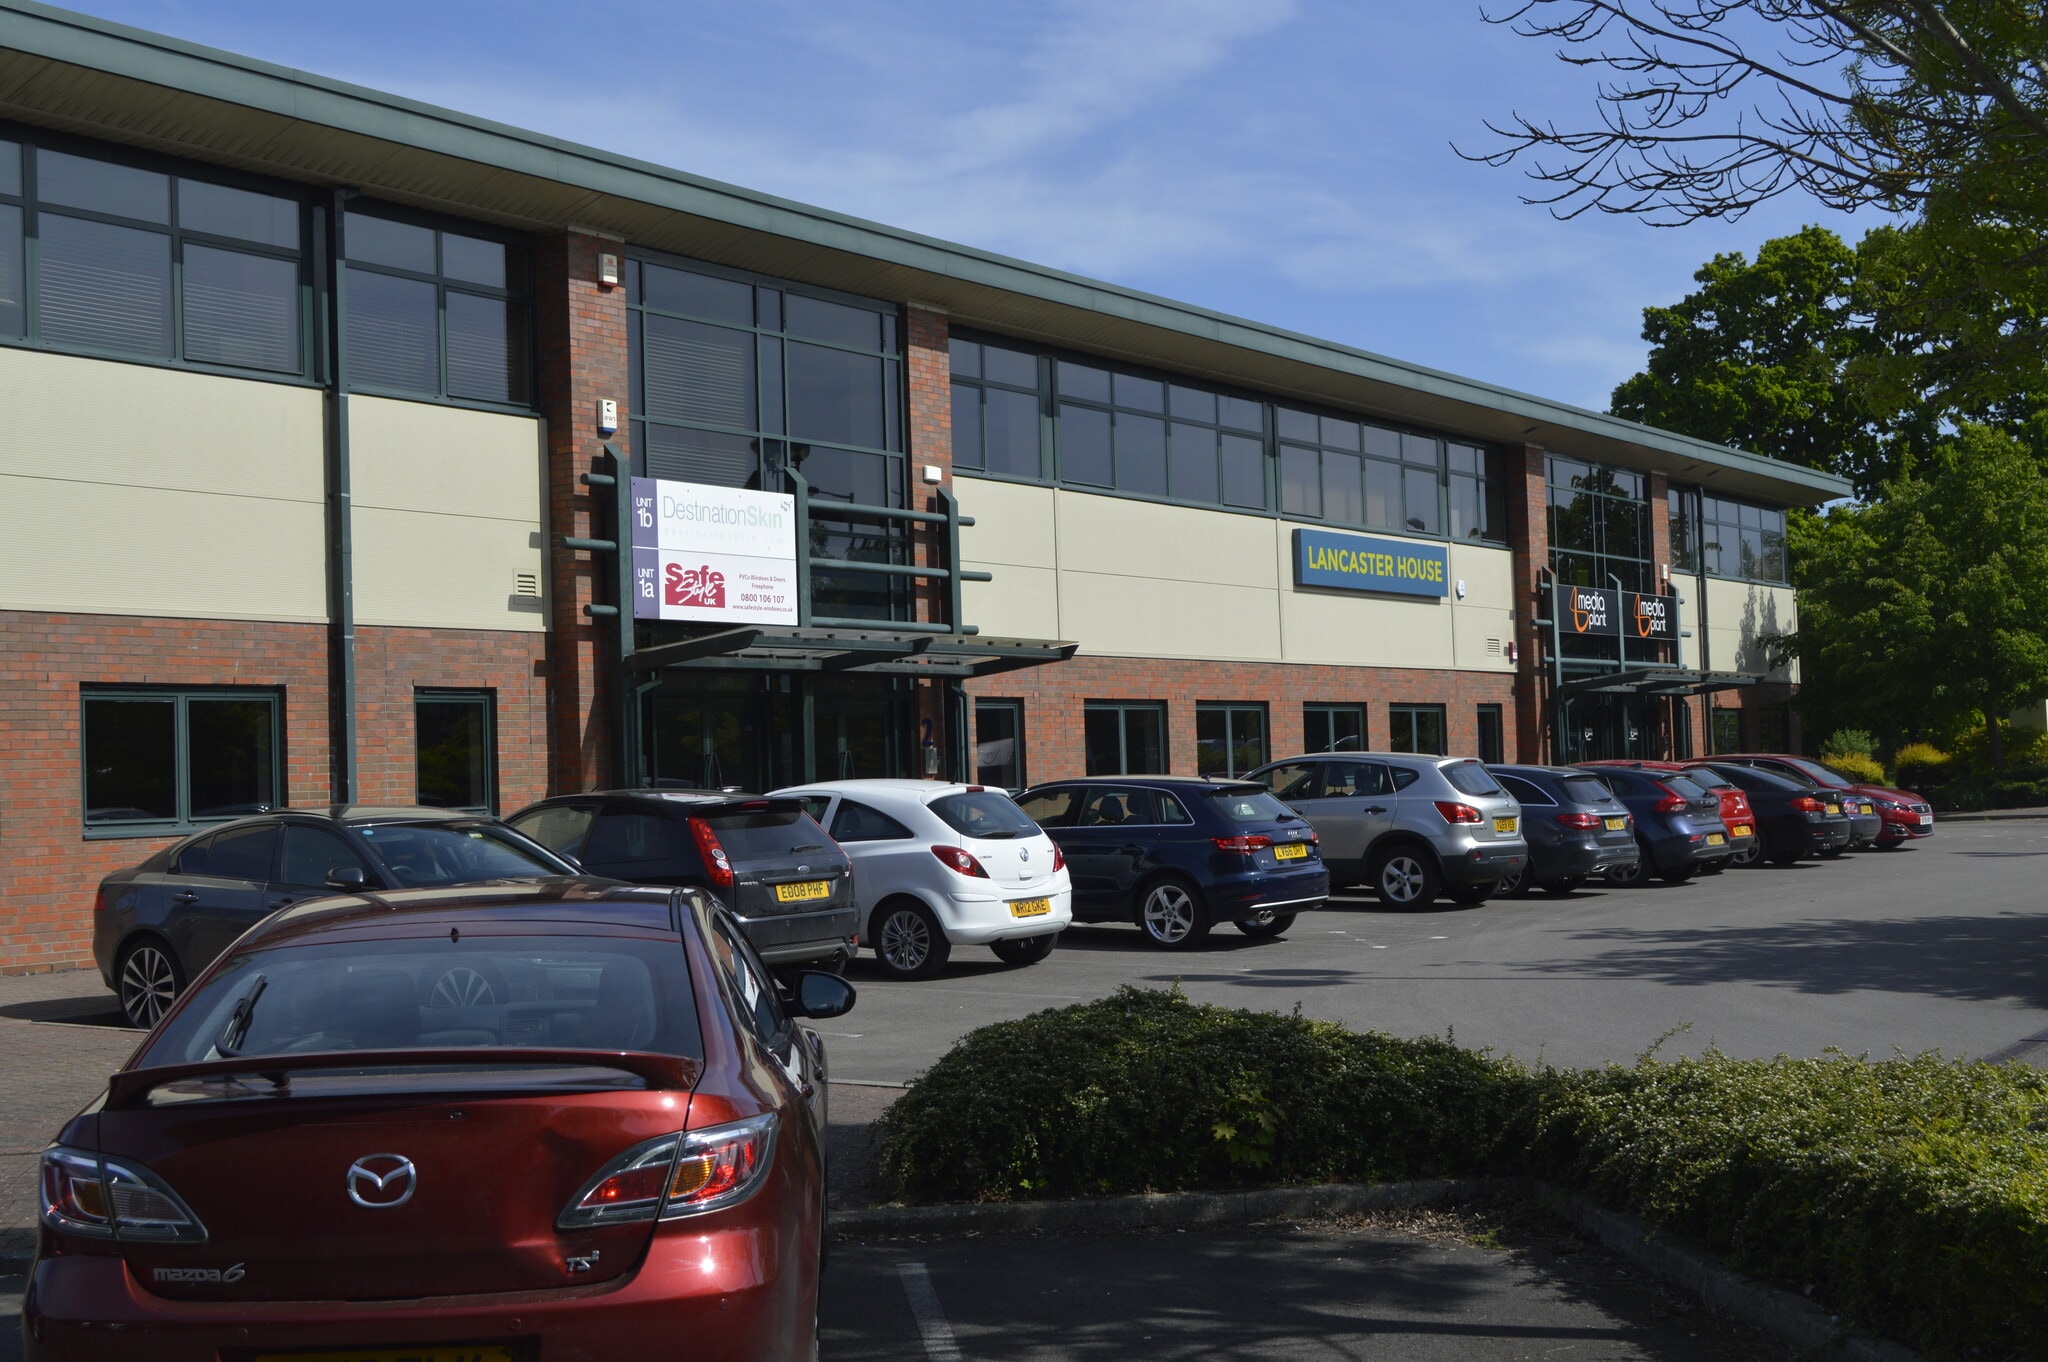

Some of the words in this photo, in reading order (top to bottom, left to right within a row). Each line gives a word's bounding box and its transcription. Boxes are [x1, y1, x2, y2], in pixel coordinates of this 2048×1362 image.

[636, 497, 653, 508] UNIT
[663, 495, 783, 529] DestinationSkin
[637, 508, 653, 528] 1b
[638, 568, 654, 579] UNIT
[665, 562, 725, 585] Safe
[1308, 545, 1394, 577] LANCASTER
[1397, 556, 1443, 583] HOUSE
[639, 578, 655, 598] 1a
[675, 579, 717, 605] Style
[704, 597, 716, 606] UK
[740, 593, 757, 602] 0800
[759, 594, 772, 603] 106
[773, 595, 785, 604] 107
[1578, 591, 1605, 611] media
[1640, 598, 1665, 616] media
[1588, 611, 1606, 630] plant
[1650, 617, 1666, 635] plant
[921, 718, 934, 747] 2
[807, 882, 823, 896] PHF
